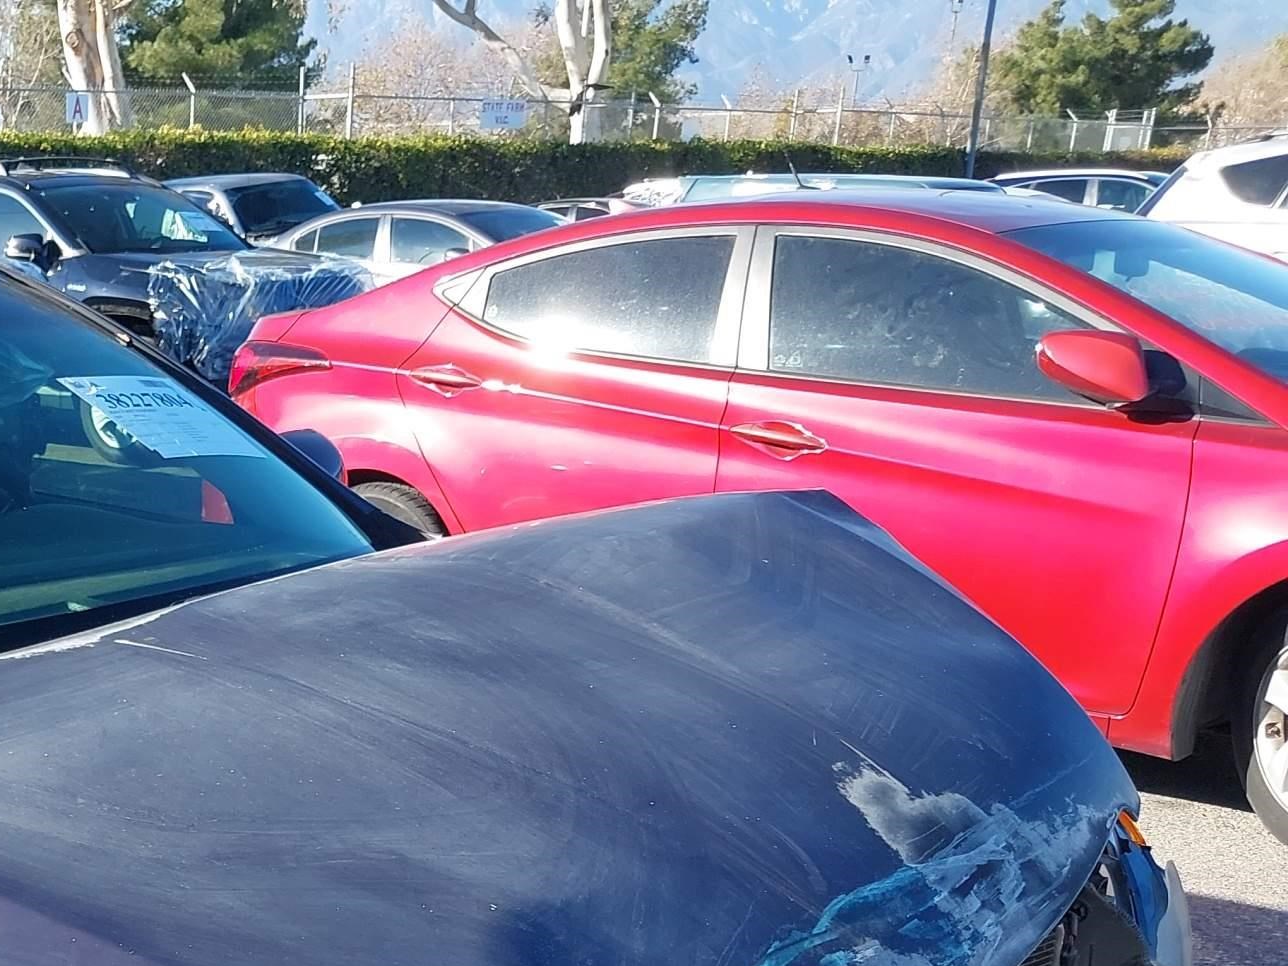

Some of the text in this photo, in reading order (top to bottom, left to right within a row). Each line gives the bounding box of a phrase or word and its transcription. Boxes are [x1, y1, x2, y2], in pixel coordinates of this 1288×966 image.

[72, 95, 83, 120] A
[482, 102, 504, 112] STATE
[95, 392, 194, 409] 38227804
